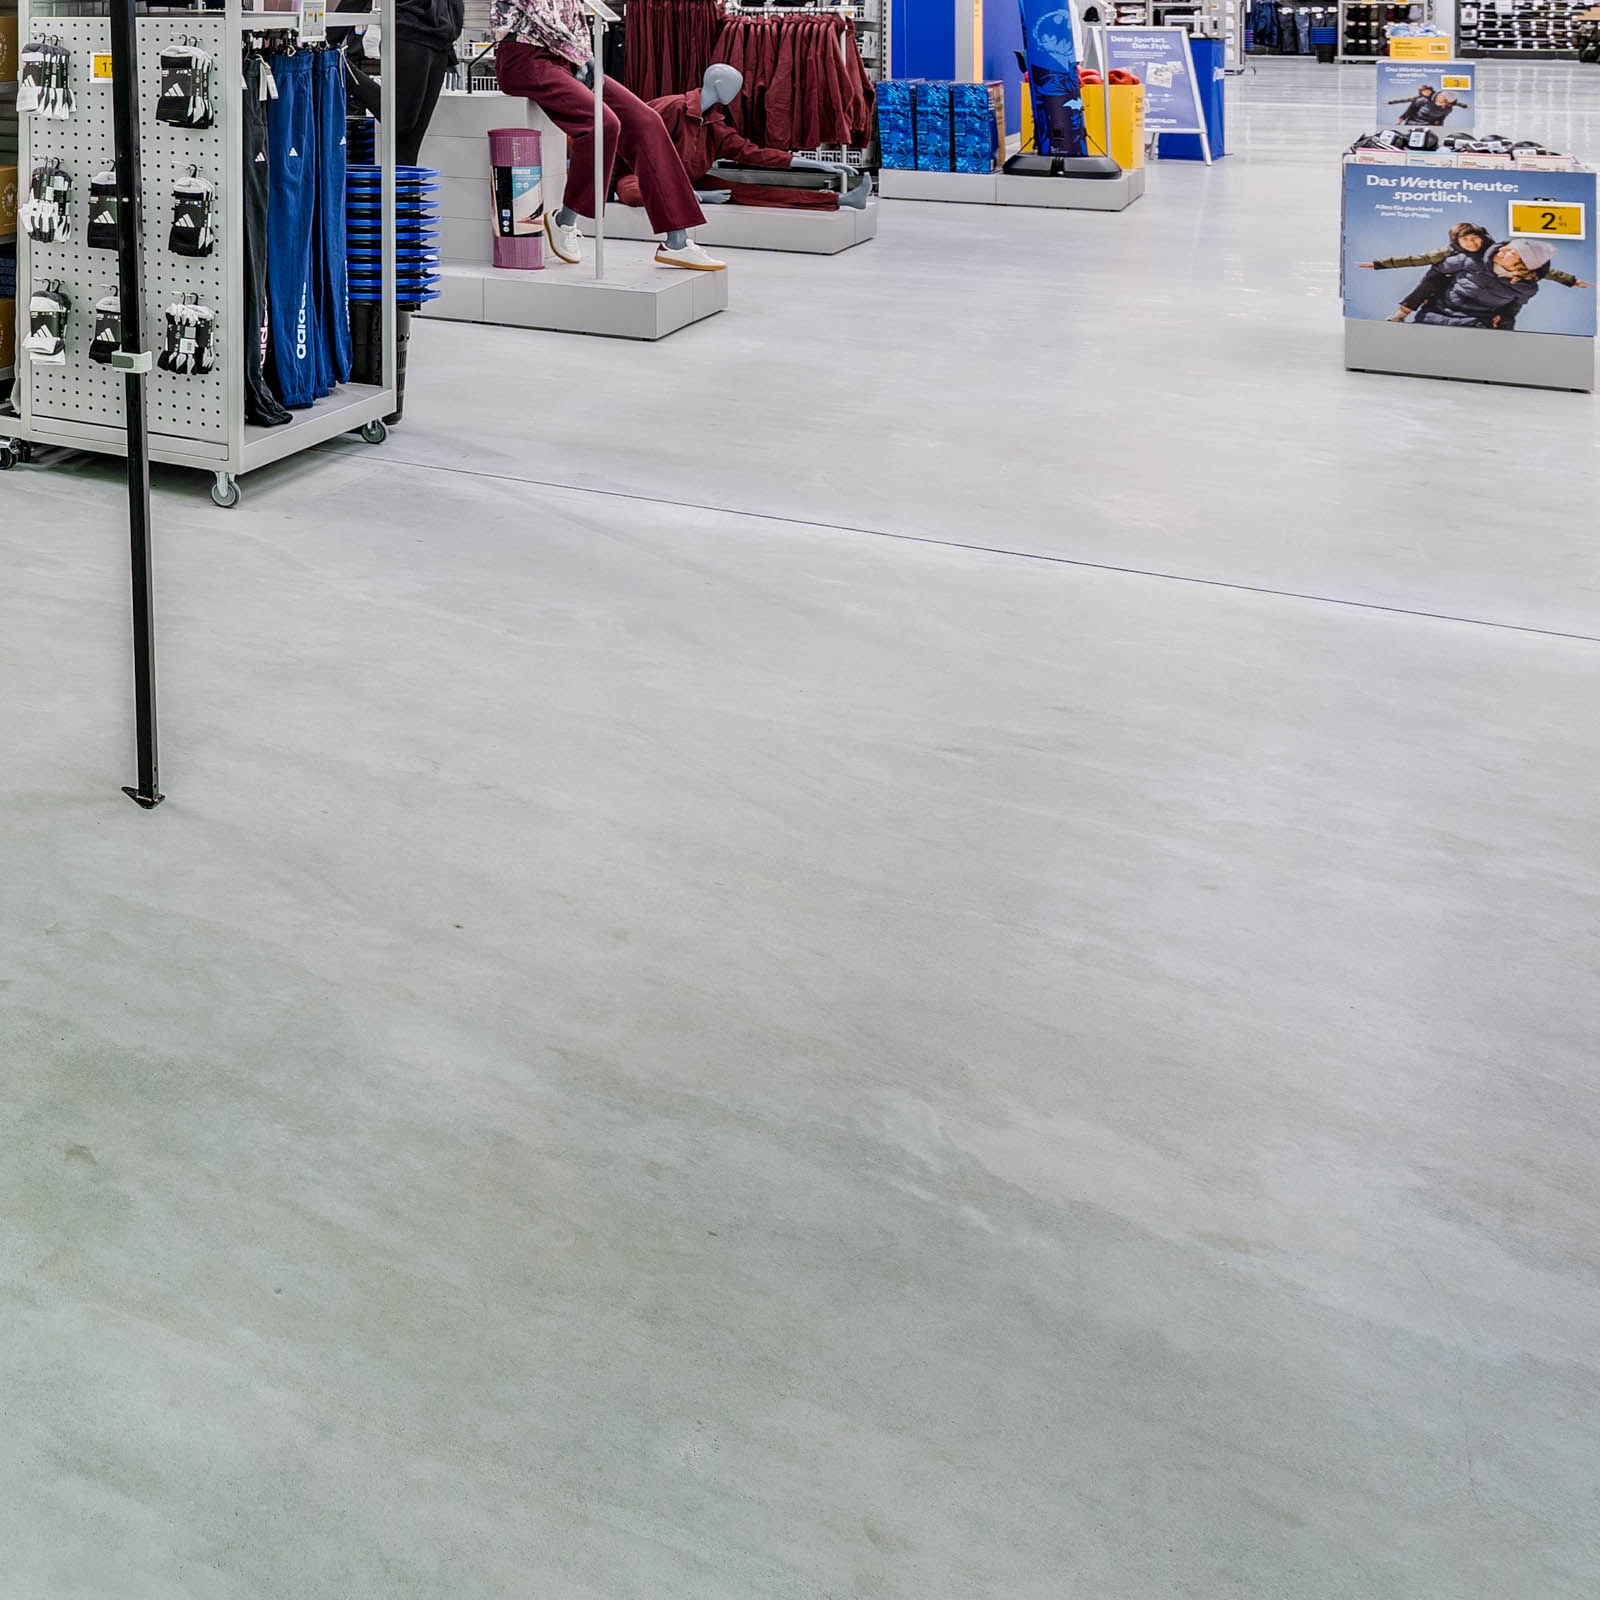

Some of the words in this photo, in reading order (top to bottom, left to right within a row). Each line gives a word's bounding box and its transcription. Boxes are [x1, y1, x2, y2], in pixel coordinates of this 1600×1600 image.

[1366, 174, 1398, 188] Das
[1400, 176, 1460, 190] Wetter
[1463, 180, 1520, 193] heute:
[1392, 190, 1473, 204] sportlich.
[1540, 212, 1558, 231] 2
